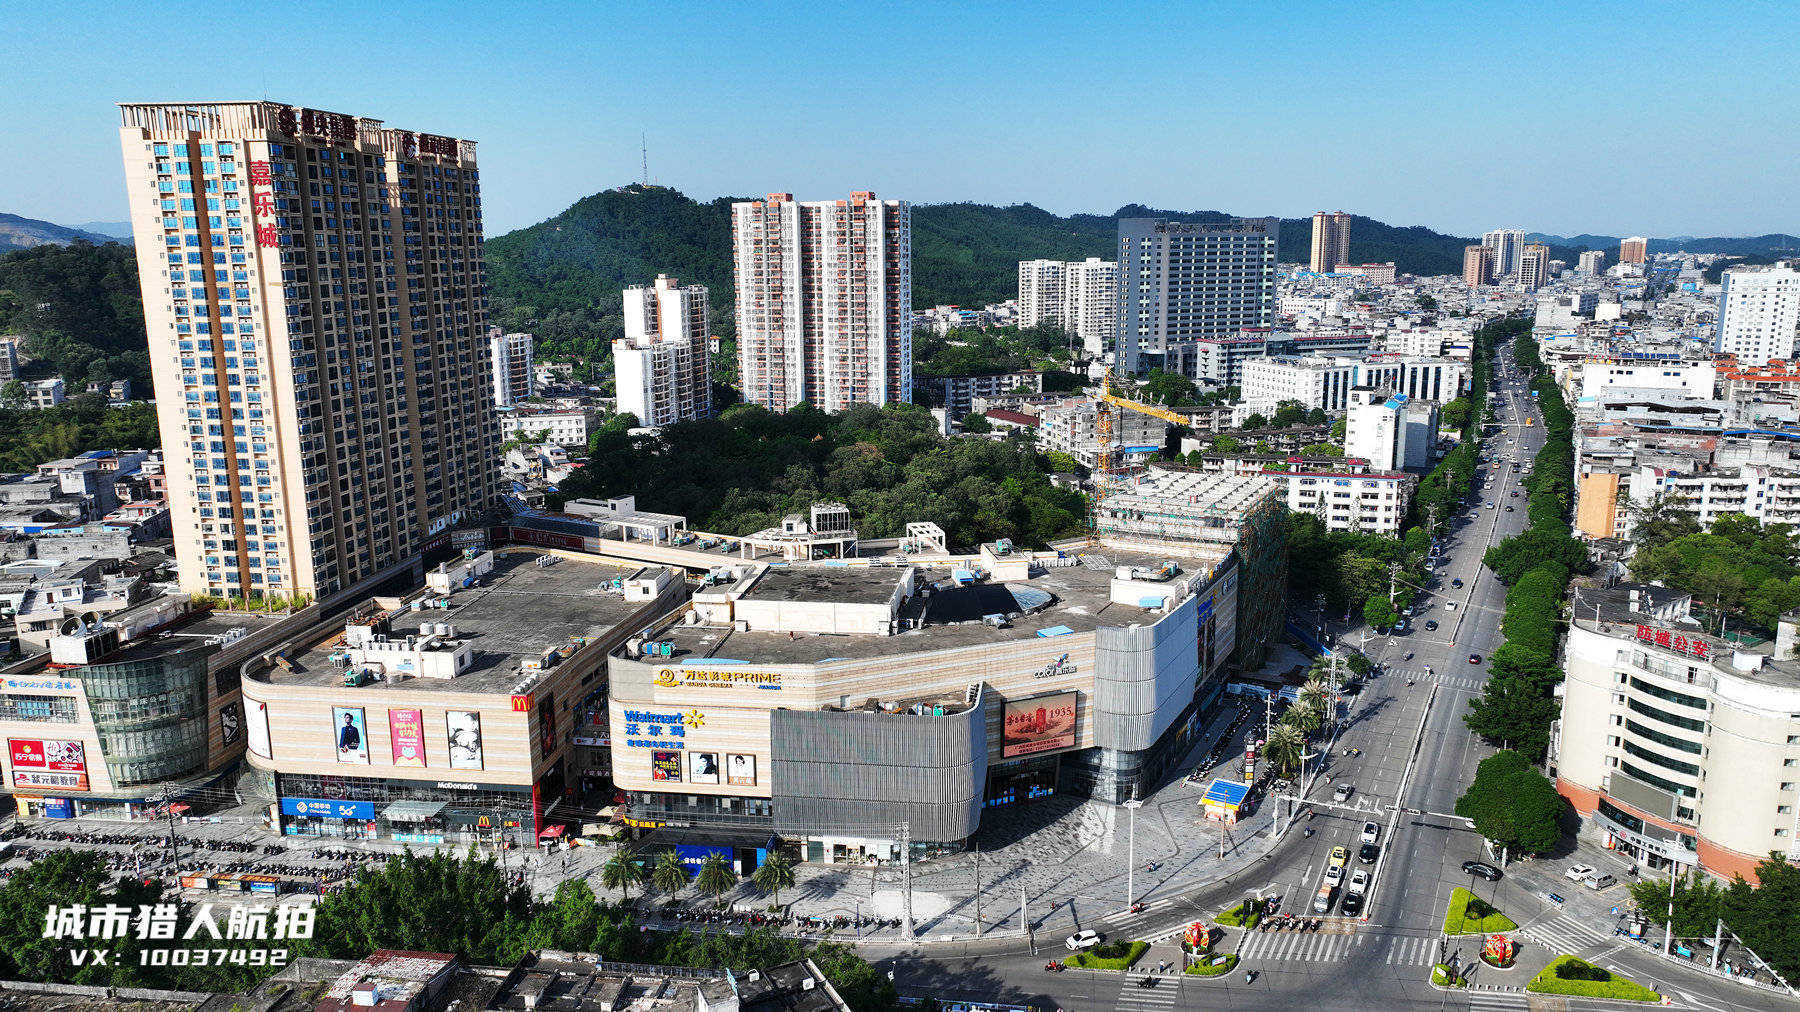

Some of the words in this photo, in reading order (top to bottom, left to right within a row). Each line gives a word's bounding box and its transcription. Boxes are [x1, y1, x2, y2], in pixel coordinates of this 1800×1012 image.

[250, 159, 279, 248] 嘉乐城
[1636, 624, 1709, 658] 防城公安
[624, 710, 684, 725] Walmart
[1049, 706, 1072, 719] 1935
[625, 723, 685, 737] 沃尔玛
[437, 781, 477, 790] McDonald's
[339, 805, 357, 816] 5G
